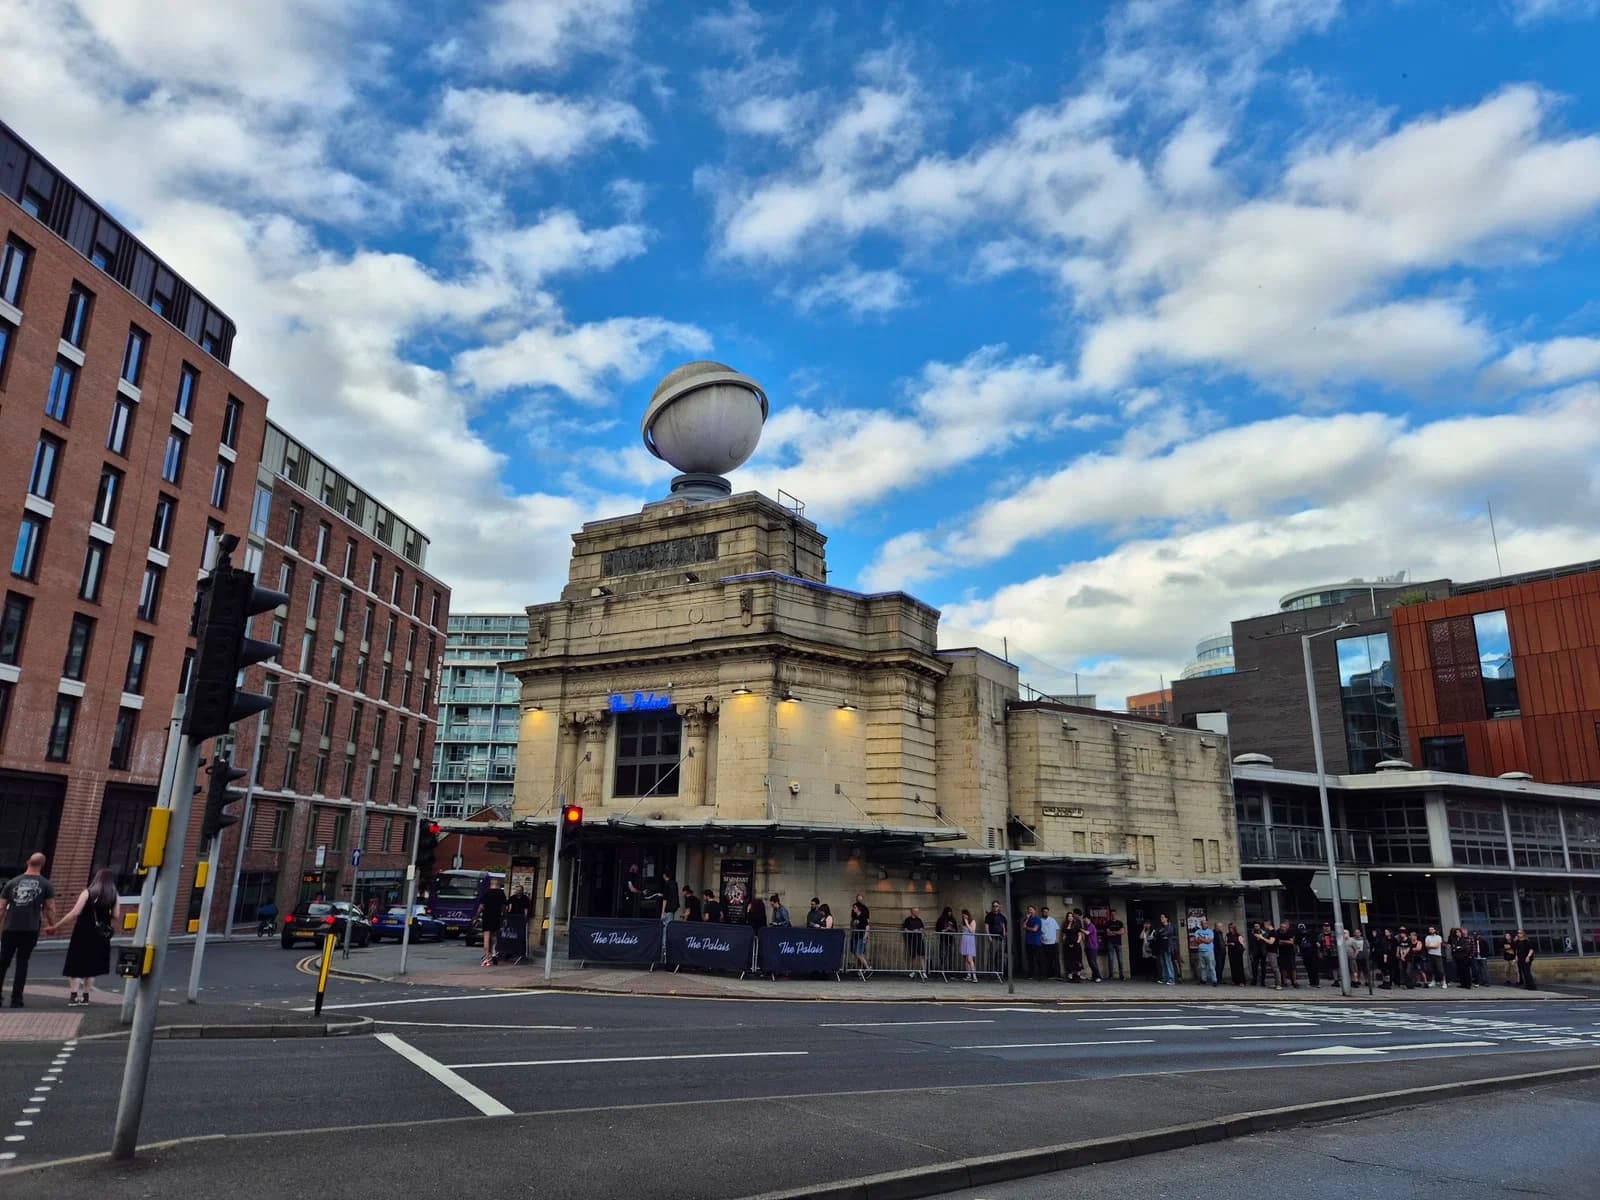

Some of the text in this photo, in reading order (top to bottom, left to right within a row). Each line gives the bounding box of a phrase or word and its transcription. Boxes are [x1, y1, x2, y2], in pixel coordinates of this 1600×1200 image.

[591, 931, 639, 945] The Palais
[685, 936, 731, 952] The Palais
[778, 941, 824, 955] The Palais
